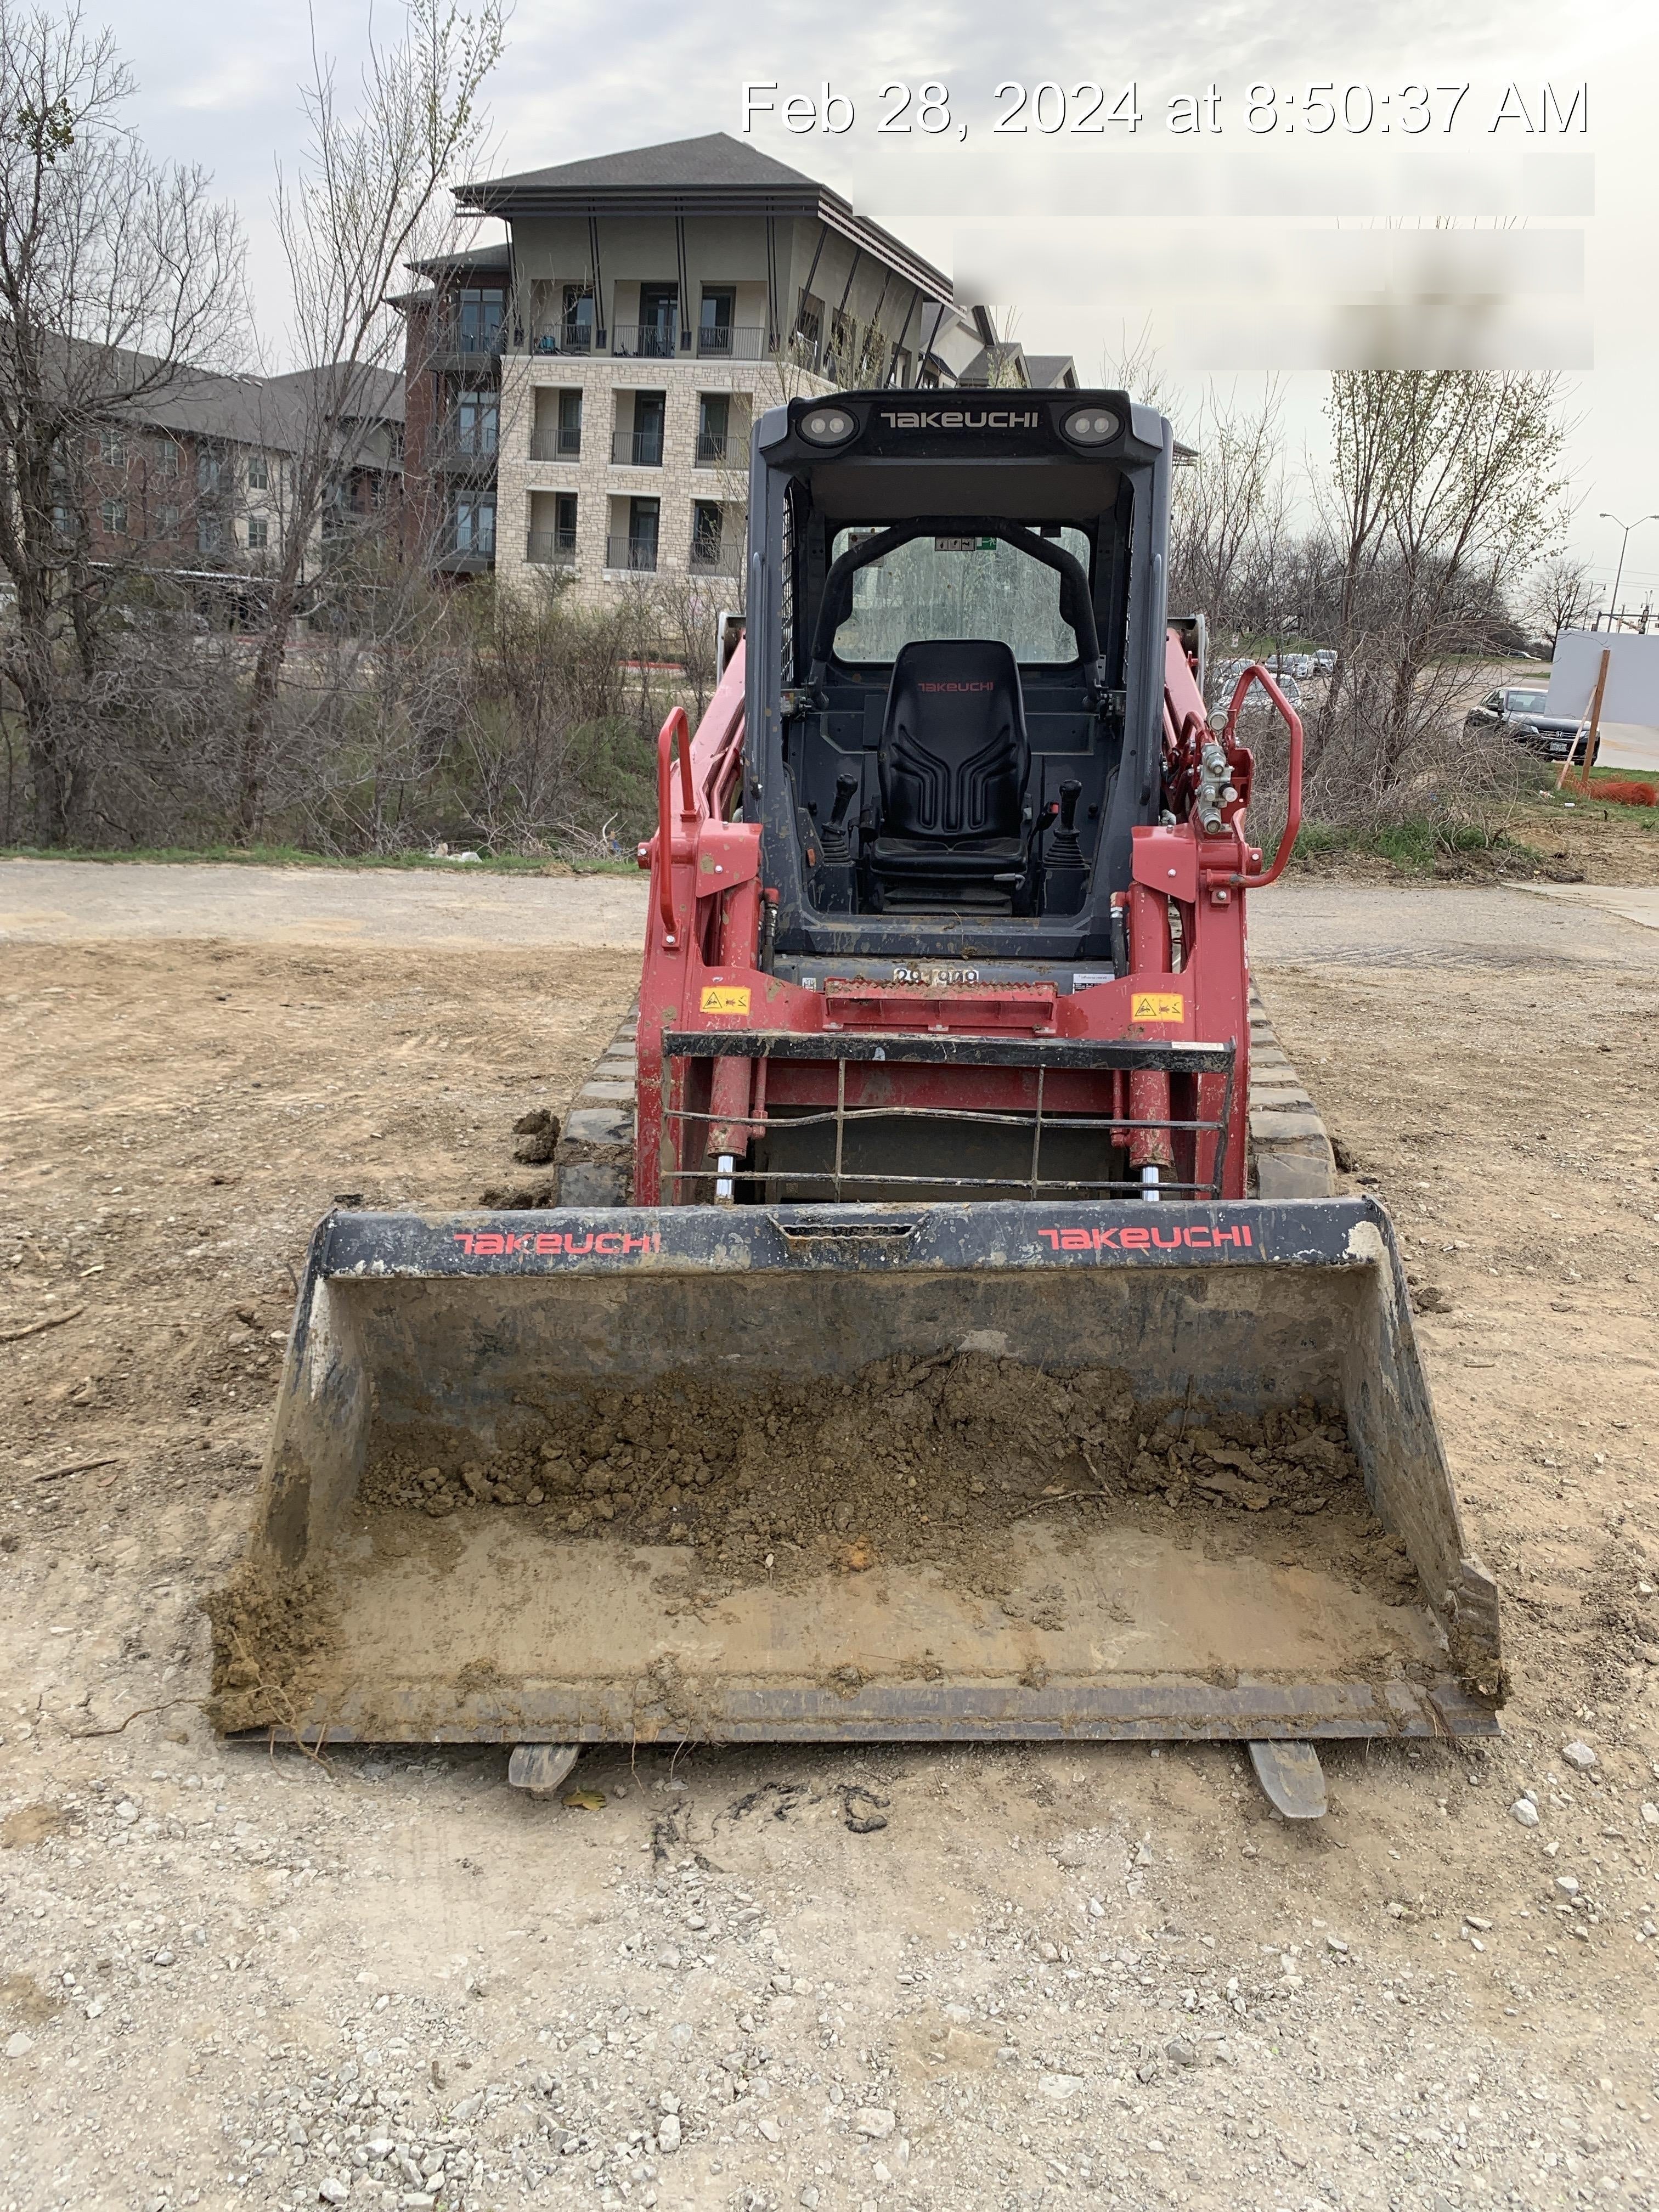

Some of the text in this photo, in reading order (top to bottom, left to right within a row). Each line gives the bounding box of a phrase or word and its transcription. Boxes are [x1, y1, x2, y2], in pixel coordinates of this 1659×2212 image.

[881, 412, 1038, 428] TAKEUCHI
[918, 682, 994, 692] TAKEUCHI
[454, 1232, 661, 1255] TAKEUCHI
[1038, 1226, 1252, 1250] TAKEUCHI
